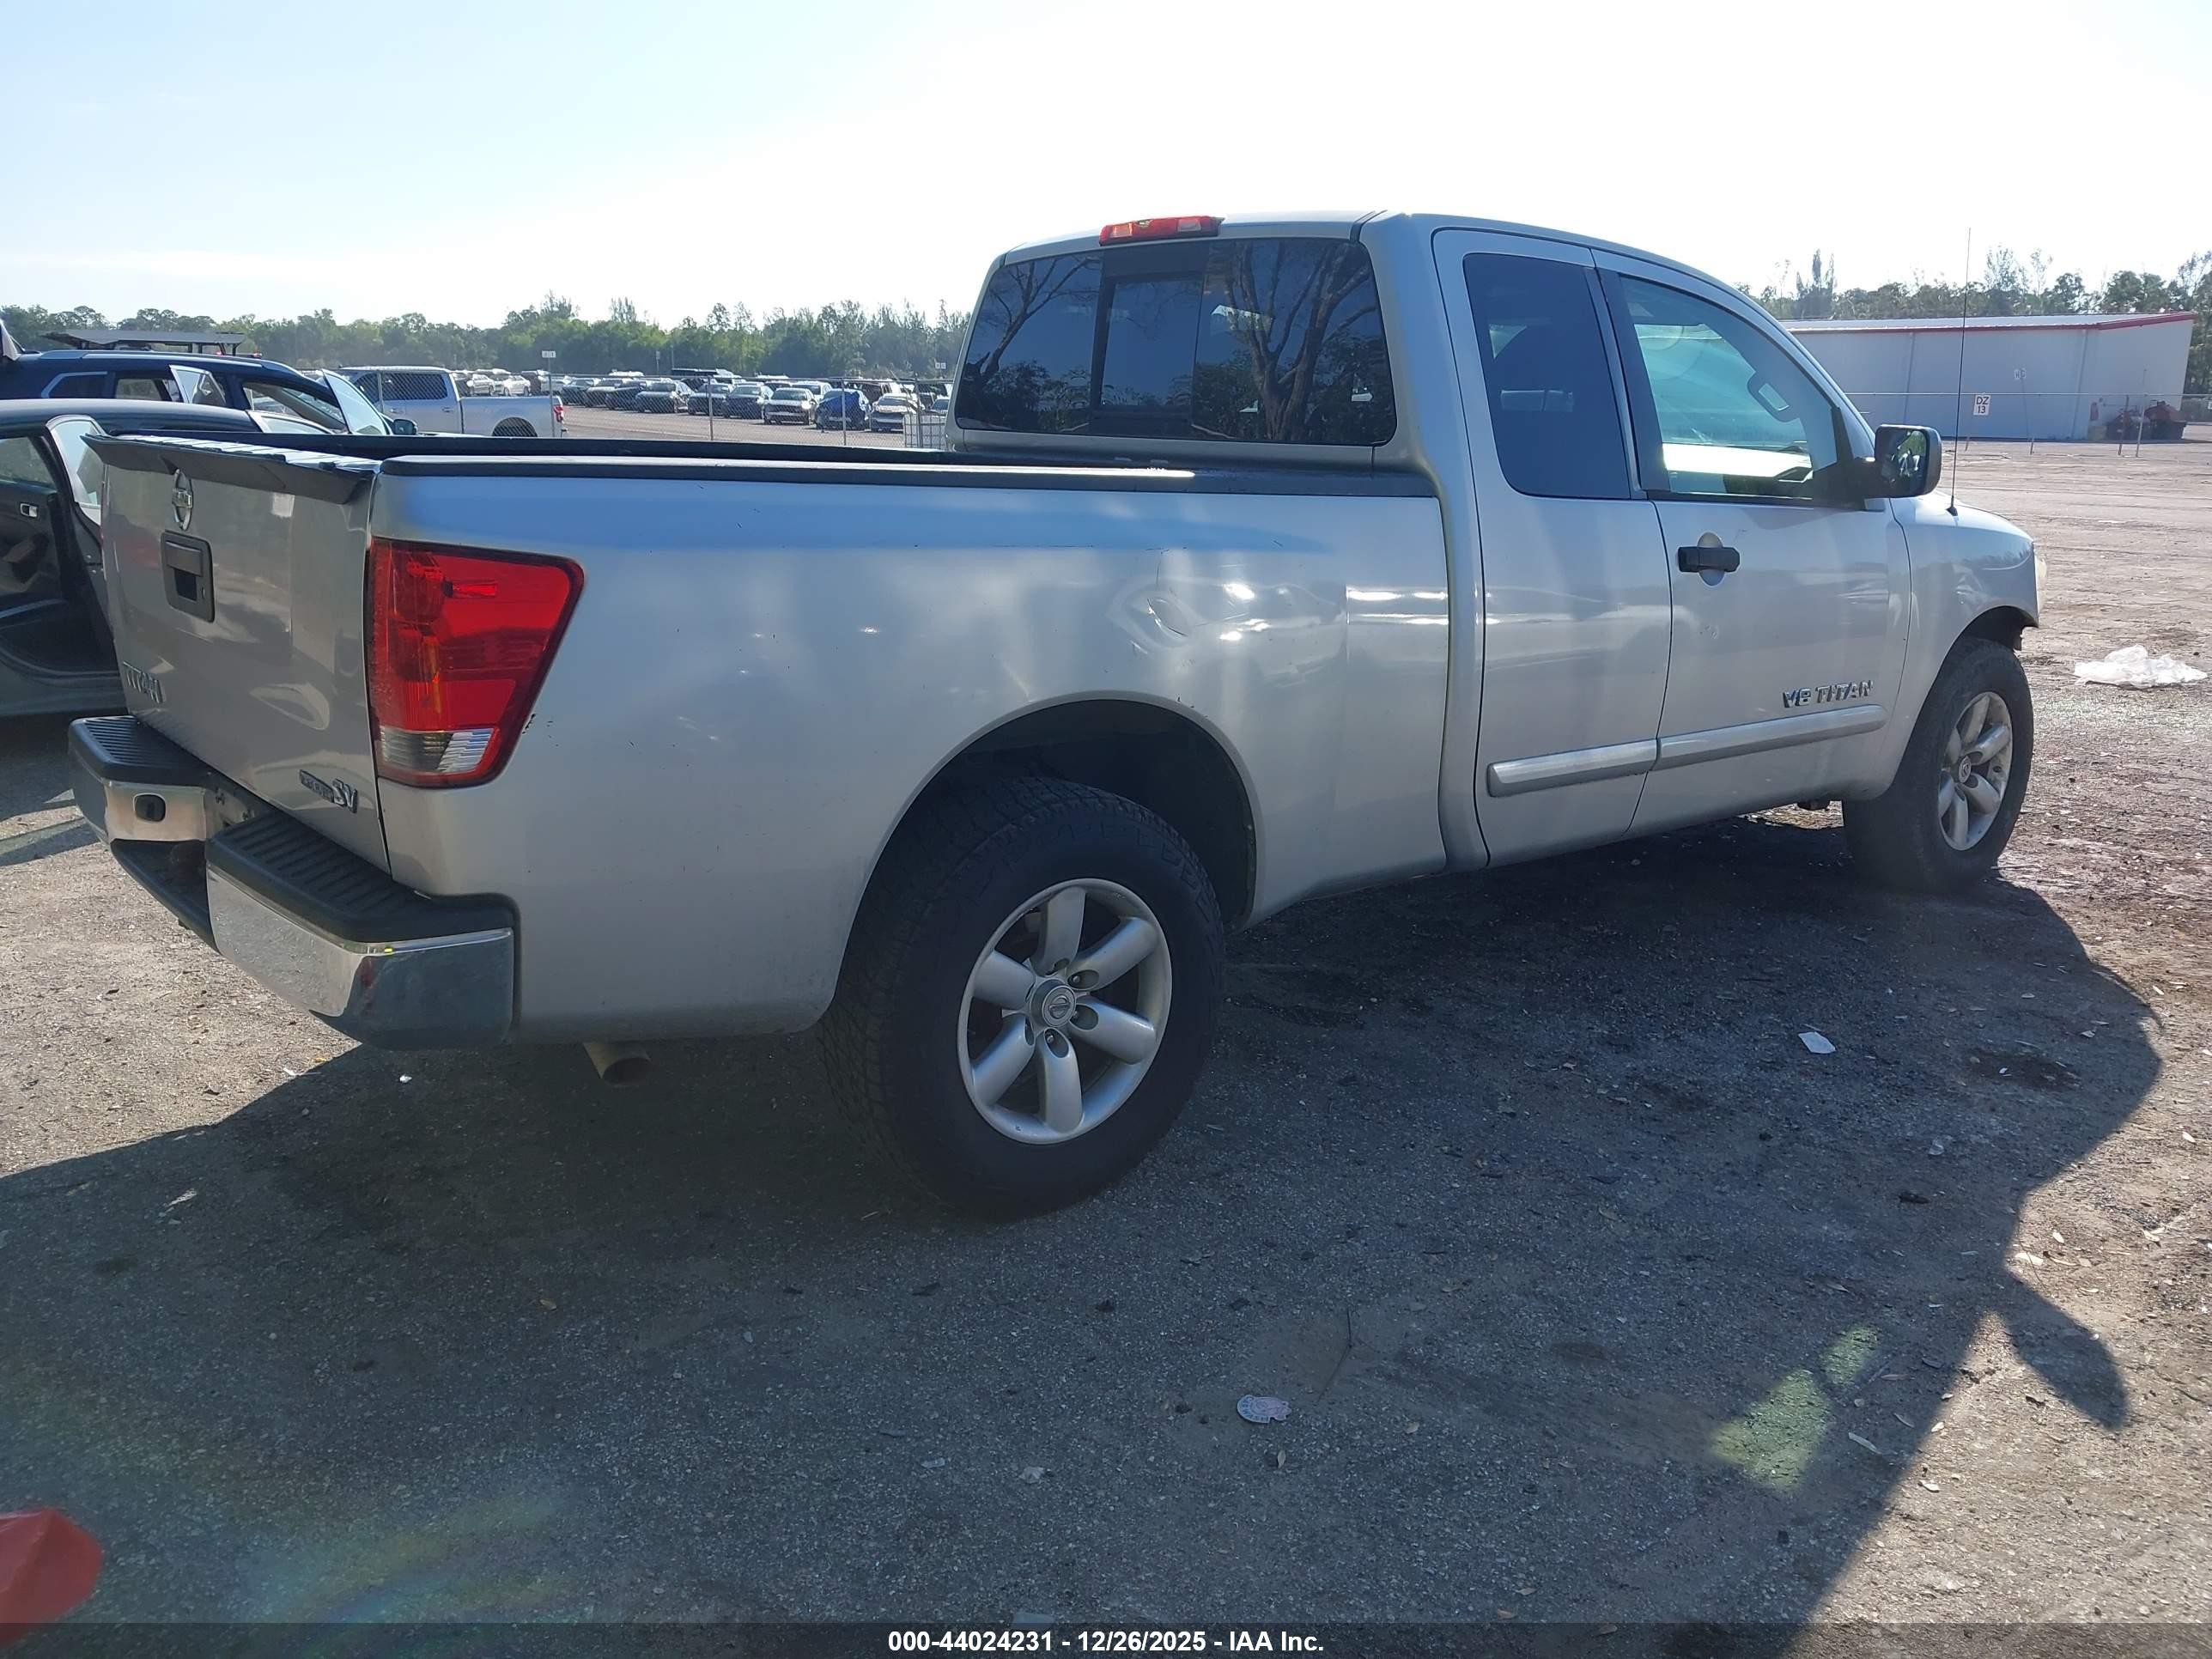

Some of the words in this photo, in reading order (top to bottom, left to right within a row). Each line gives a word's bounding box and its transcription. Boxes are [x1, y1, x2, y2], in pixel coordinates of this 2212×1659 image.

[1976, 397, 1990, 405] DZ
[1978, 405, 1986, 414] 13
[1782, 688, 1812, 708] V8
[1814, 680, 1874, 703] TITAN
